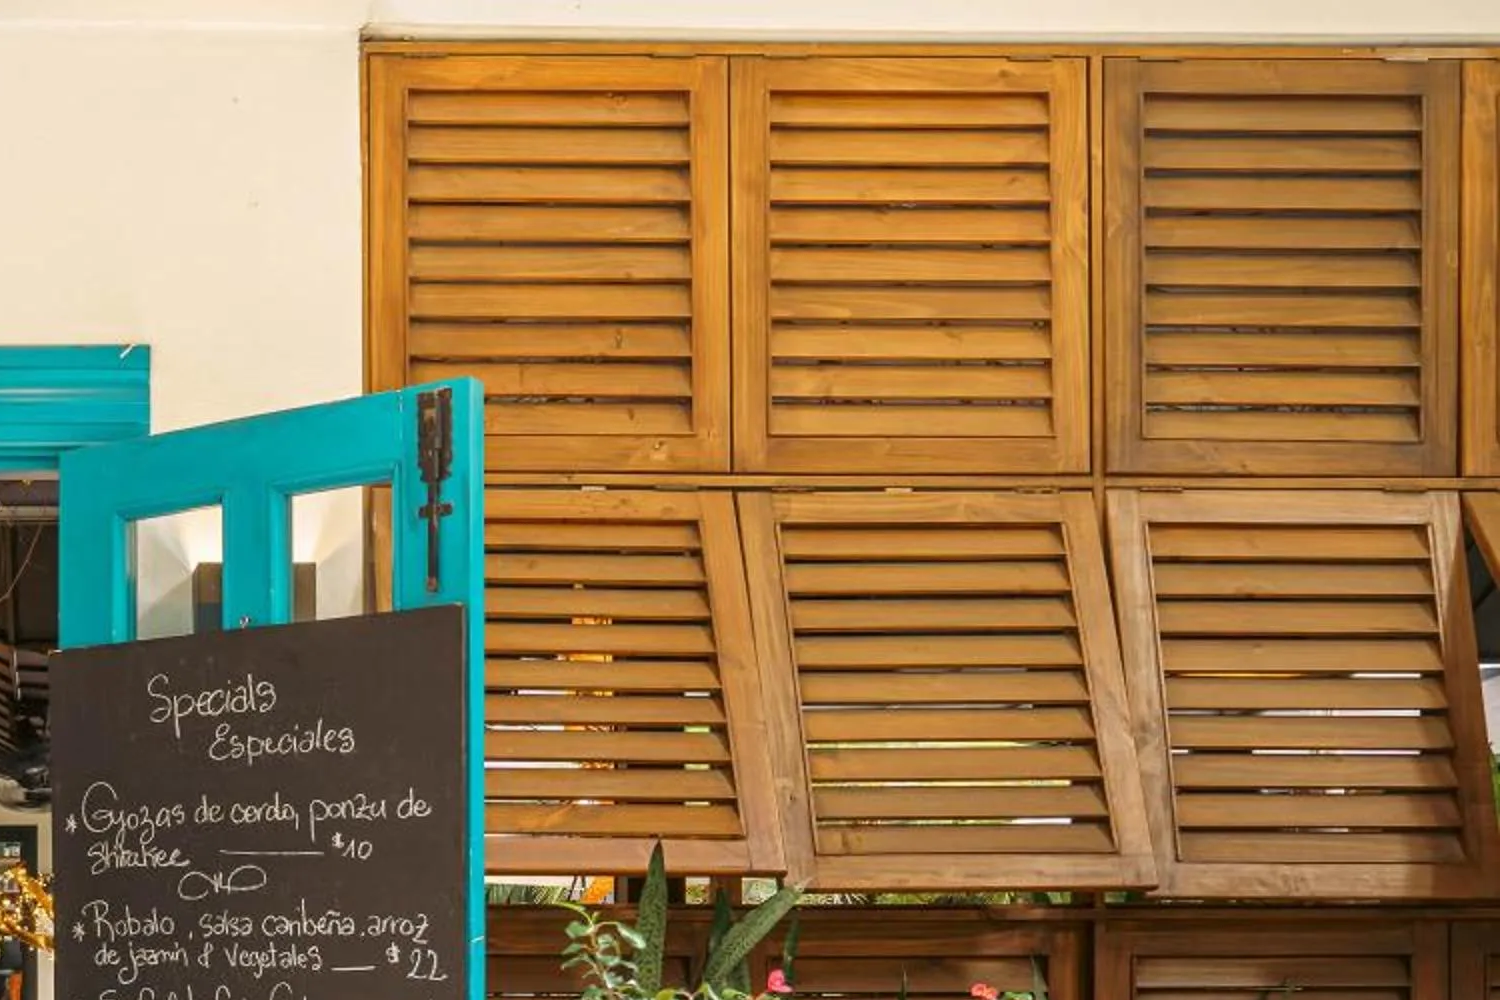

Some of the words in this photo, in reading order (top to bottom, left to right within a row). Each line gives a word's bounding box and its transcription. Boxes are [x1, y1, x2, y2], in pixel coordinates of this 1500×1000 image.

[147, 674, 277, 739] Specials
[209, 719, 356, 766] Especiales
[81, 781, 186, 845] Gyozas
[194, 795, 223, 822] de
[309, 793, 388, 844] ponzu
[397, 787, 433, 819] de
[199, 907, 253, 939] salsa
[367, 912, 431, 945] arroz
[94, 942, 121, 967] de
